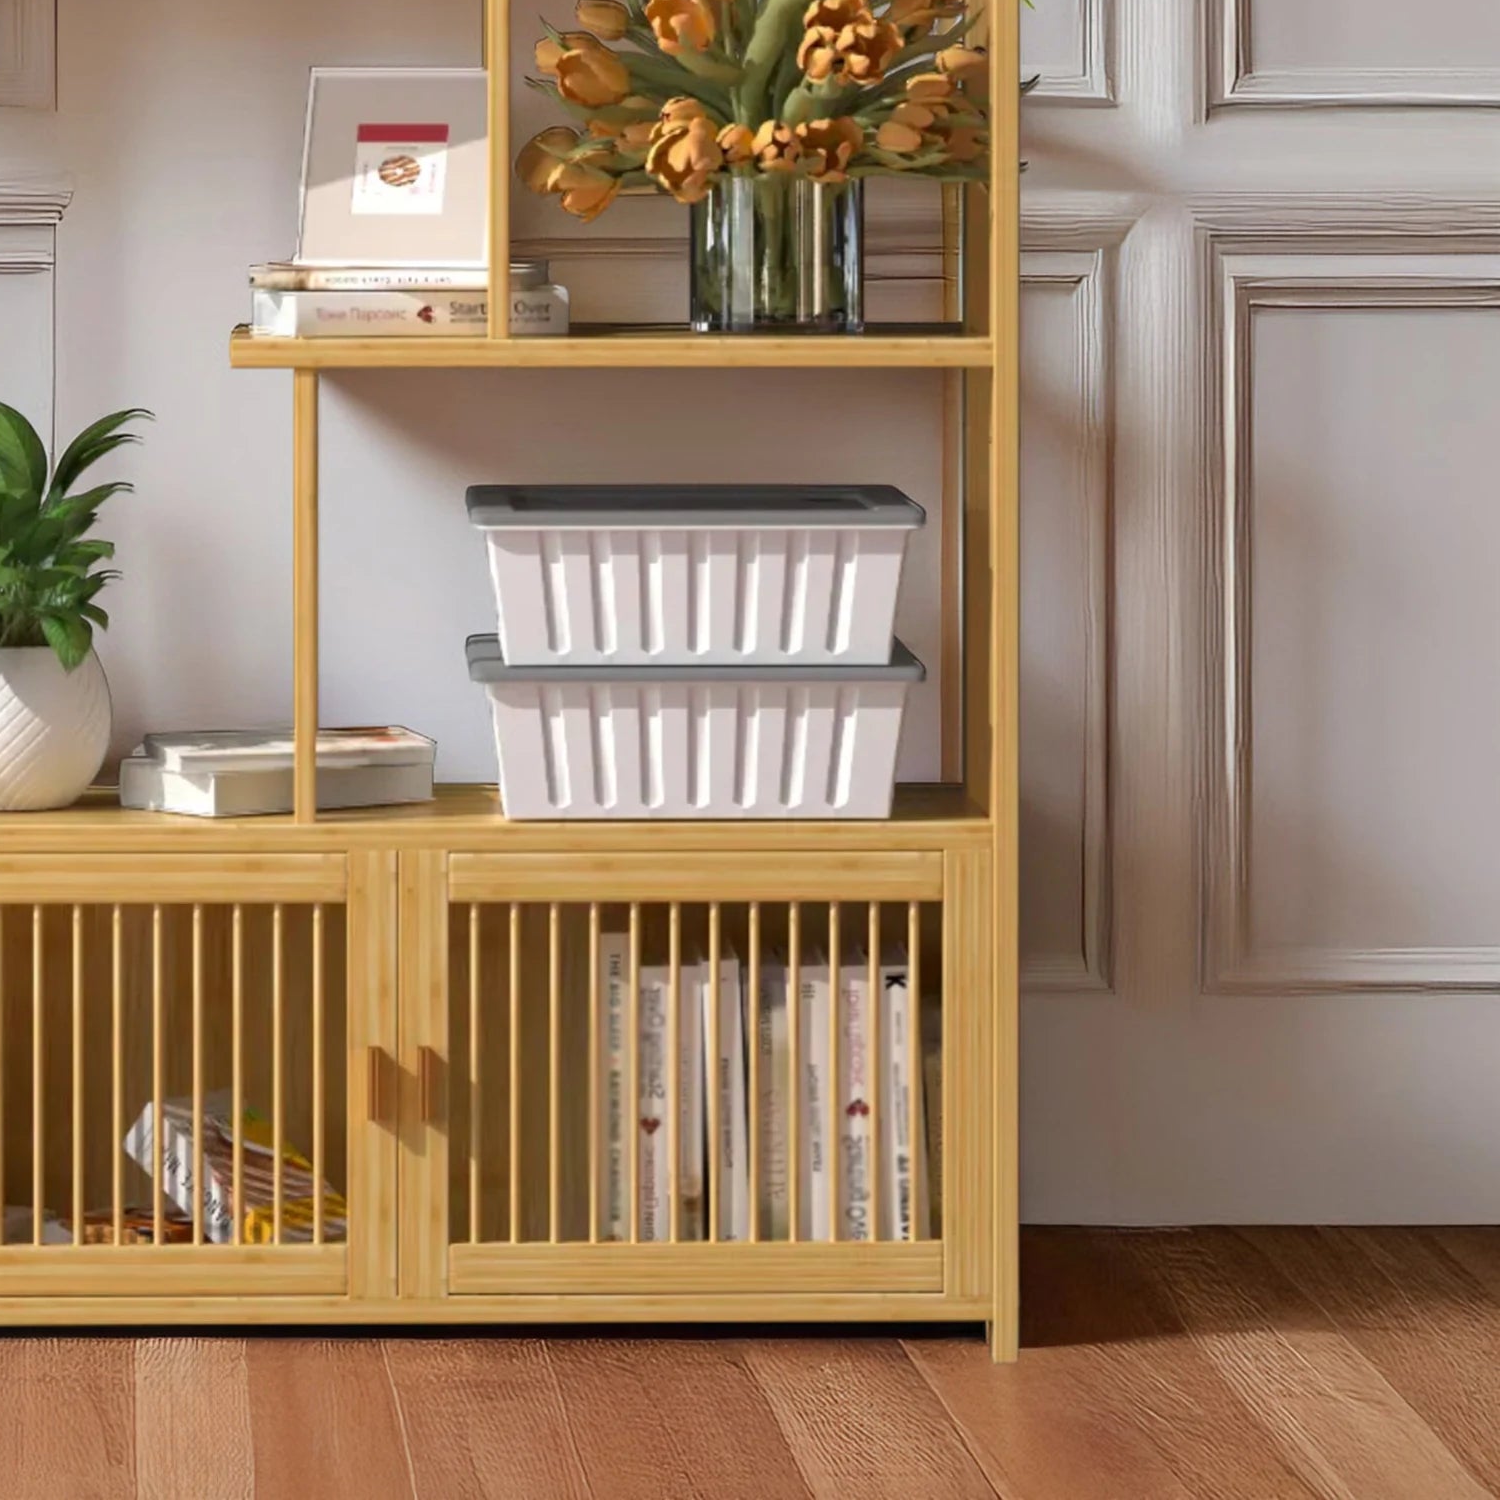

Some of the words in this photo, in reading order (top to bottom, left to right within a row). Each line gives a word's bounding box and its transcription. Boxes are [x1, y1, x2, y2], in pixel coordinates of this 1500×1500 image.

[449, 300, 488, 315] Start
[514, 300, 551, 314] Over
[609, 953, 621, 976] THE
